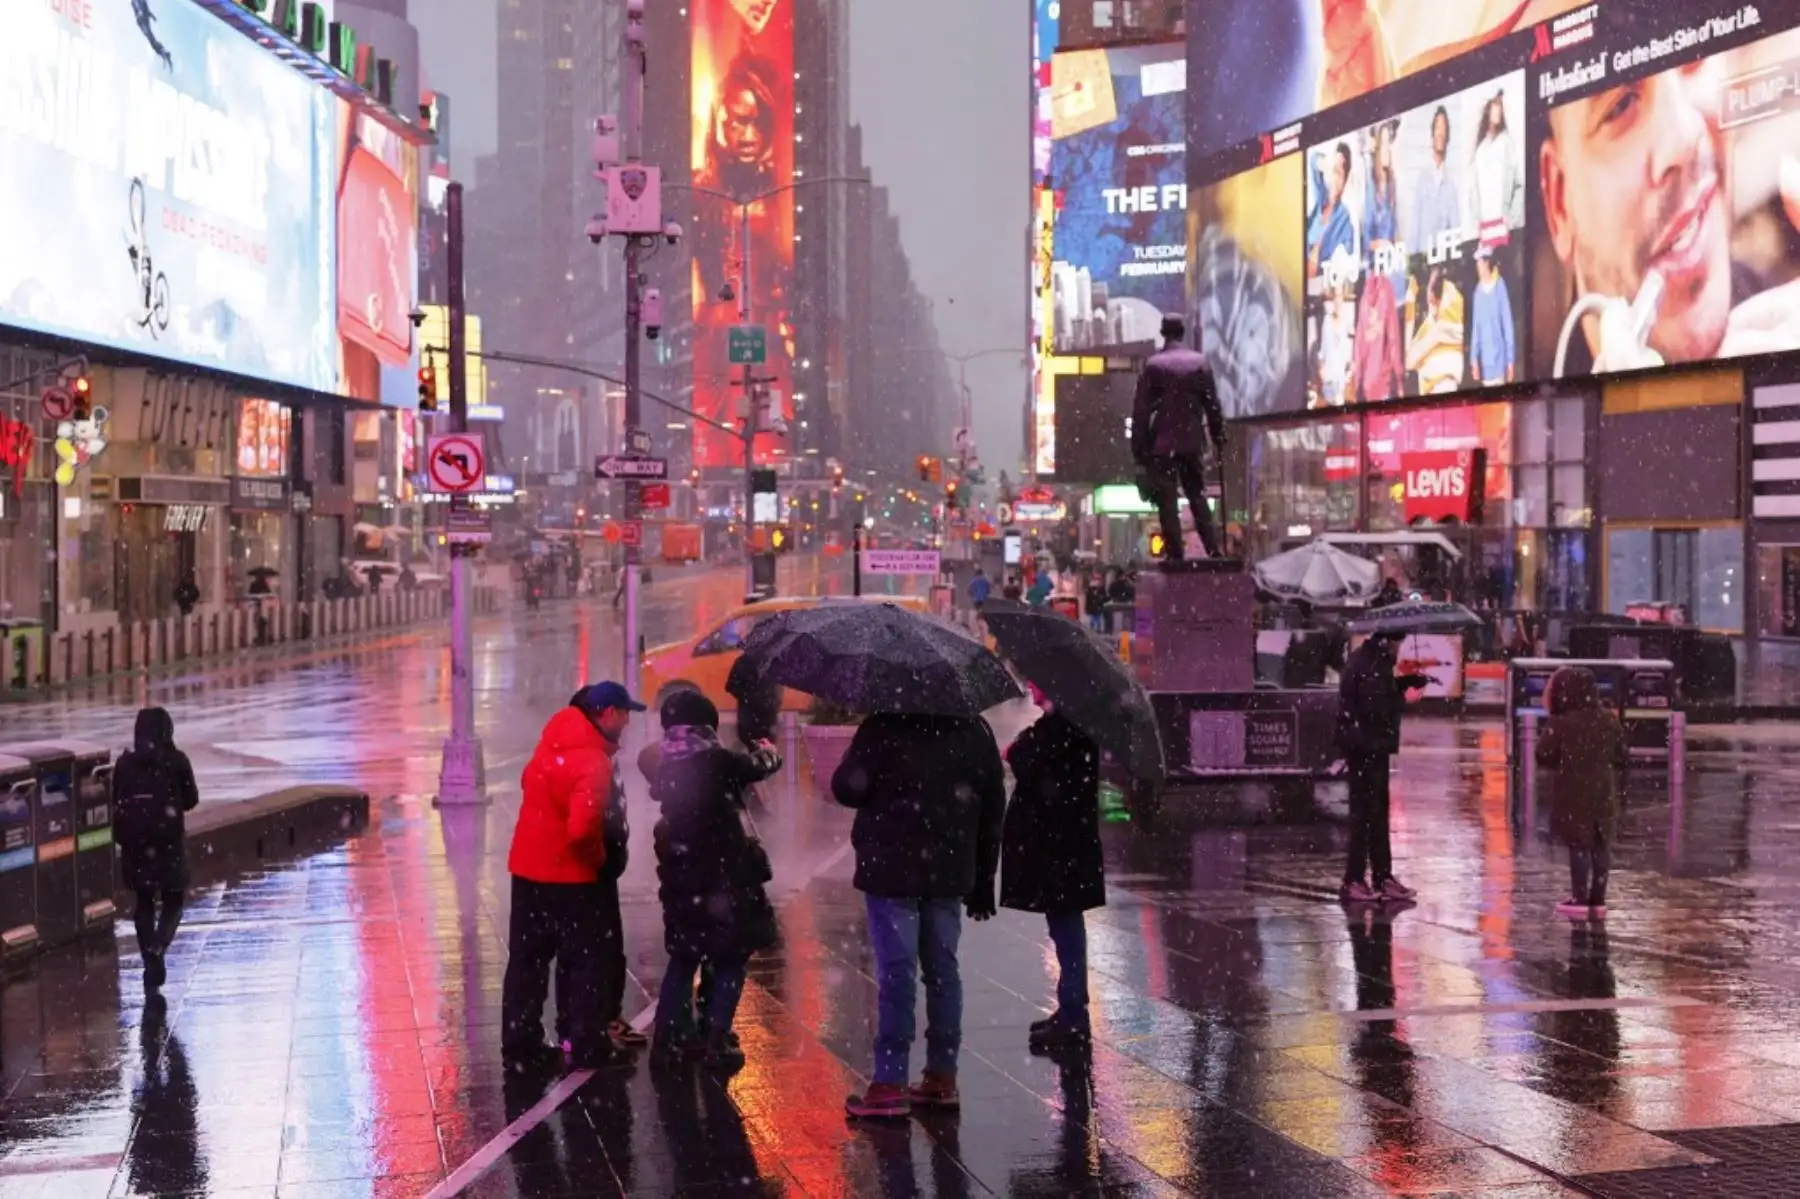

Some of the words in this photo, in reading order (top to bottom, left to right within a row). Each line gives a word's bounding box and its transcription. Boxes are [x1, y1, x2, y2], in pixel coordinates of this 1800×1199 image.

[1674, 27, 1699, 50] Skin
[1102, 186, 1158, 214] THE
[1133, 245, 1187, 259] TUESDAY
[1426, 228, 1463, 265] LIFE
[1121, 261, 1187, 276] FEBRUARY
[637, 463, 658, 472] WAY
[1252, 721, 1288, 733] TIMES
[1249, 734, 1292, 746] SQUARE
